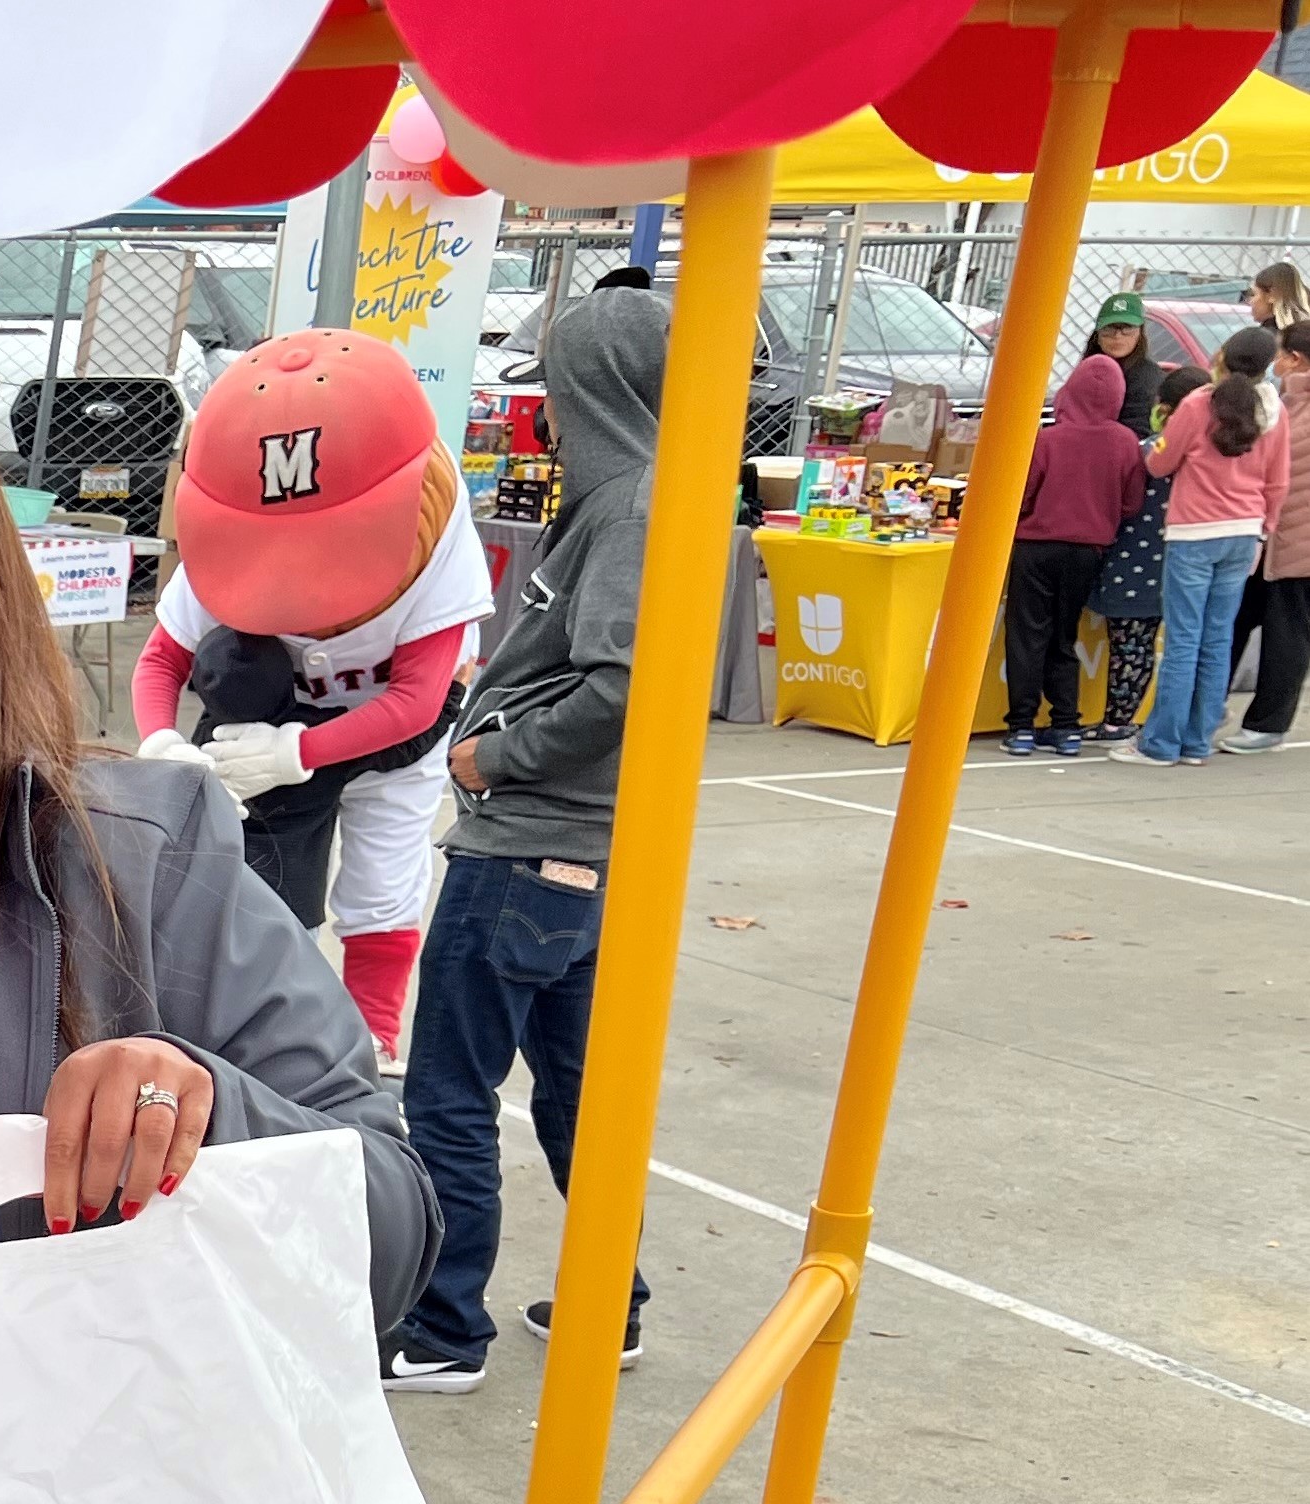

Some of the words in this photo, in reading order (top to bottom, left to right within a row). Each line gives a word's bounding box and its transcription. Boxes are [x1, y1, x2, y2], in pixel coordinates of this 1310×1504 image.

[355, 273, 453, 323] enture
[413, 369, 445, 382] EN!
[260, 428, 321, 503] M
[781, 661, 867, 690] CONTIGO
